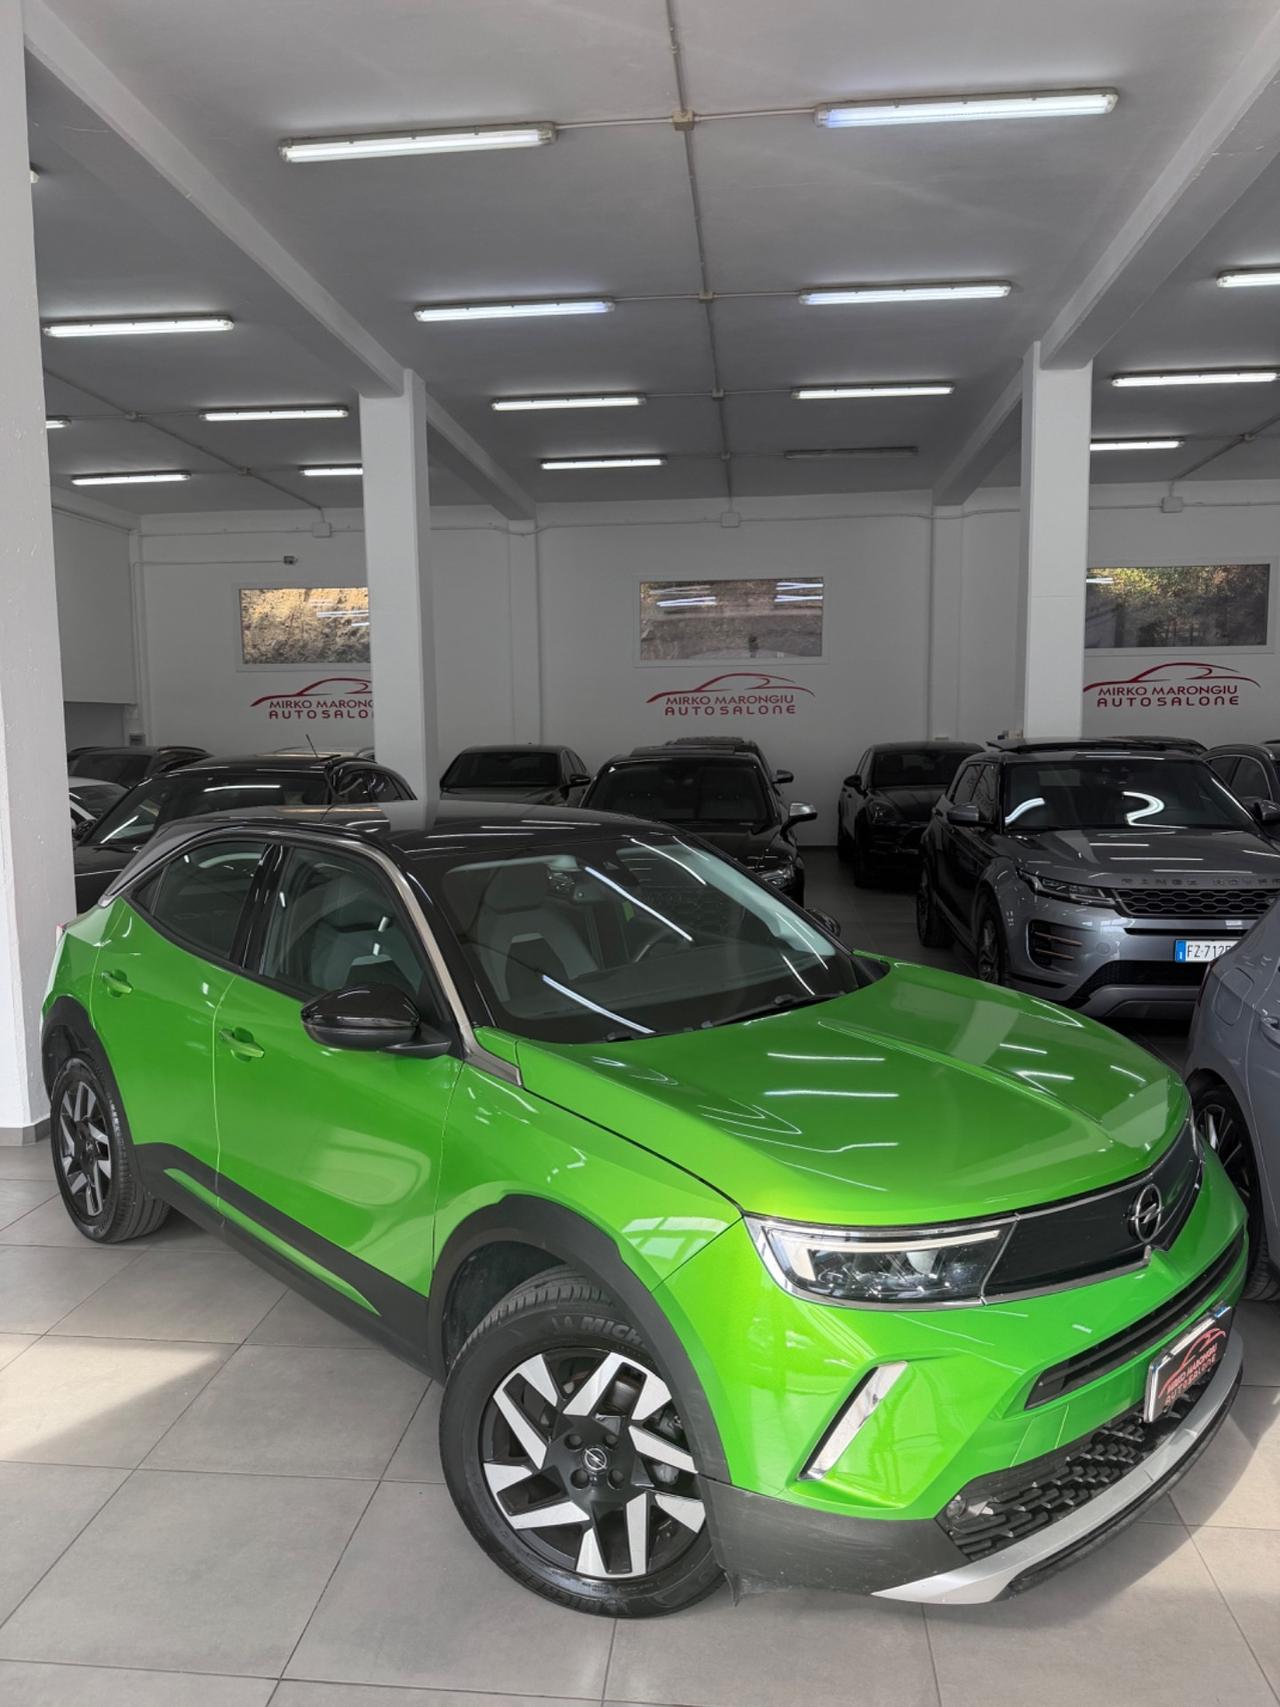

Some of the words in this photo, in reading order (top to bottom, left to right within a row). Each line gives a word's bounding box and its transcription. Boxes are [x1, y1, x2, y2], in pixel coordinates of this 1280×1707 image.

[1098, 685, 1147, 696] MIRKO
[1151, 684, 1238, 696] MARONGIU
[269, 699, 312, 709] MIRKO
[665, 695, 711, 706] MIRKO
[714, 694, 794, 705] MARONGIU
[1096, 695, 1240, 708] AUTOSALONE
[269, 709, 374, 720] AUTOSALO
[665, 704, 796, 717] AUTOSALONE
